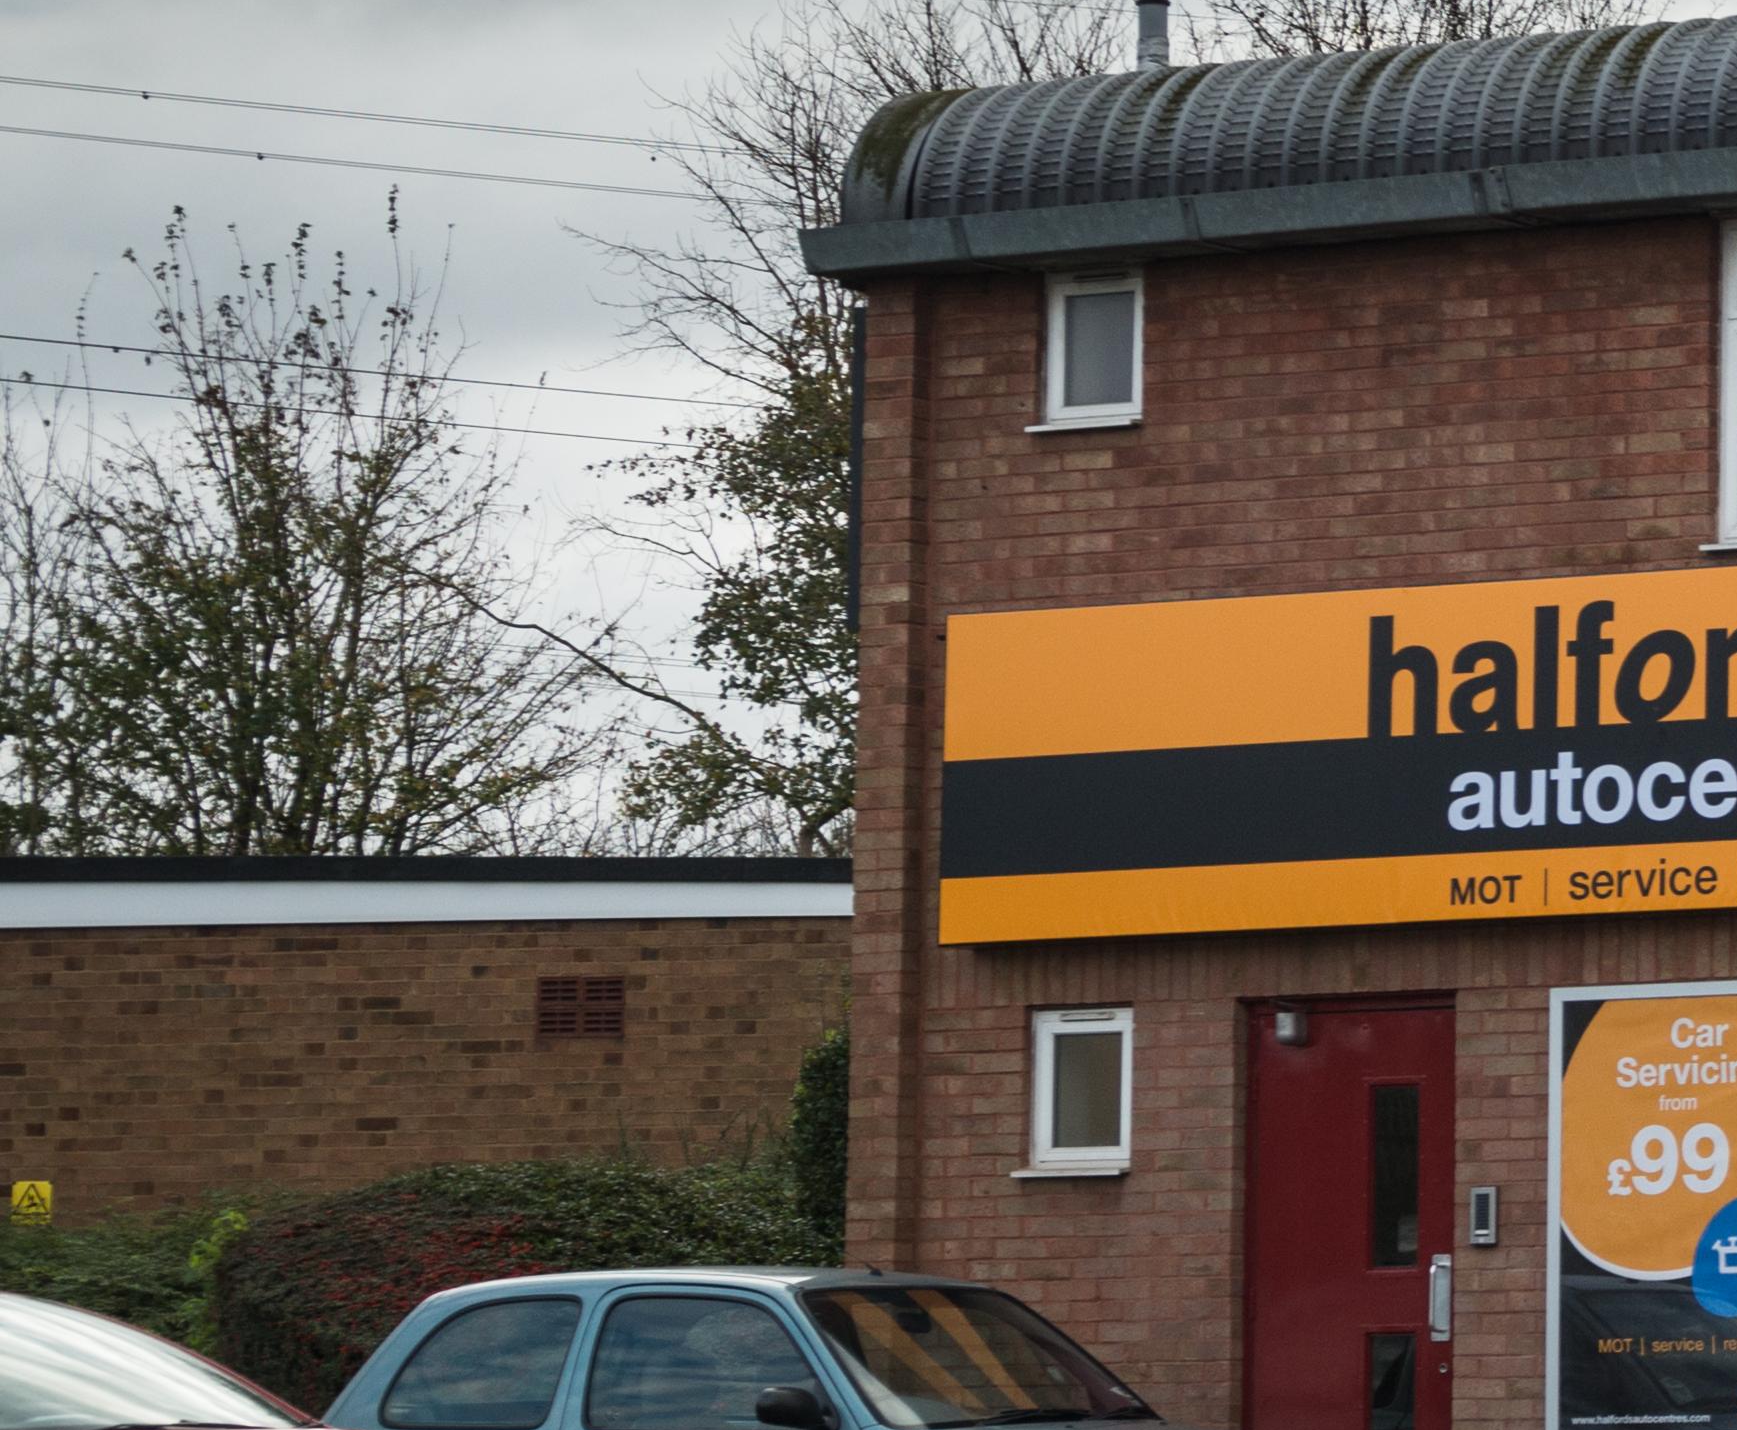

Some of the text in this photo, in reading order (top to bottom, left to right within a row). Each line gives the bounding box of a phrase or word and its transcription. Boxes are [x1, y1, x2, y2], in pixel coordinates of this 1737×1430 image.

[1450, 874, 1523, 905] MOT
[1568, 859, 1718, 901] service
[1670, 1017, 1729, 1049] Car
[1659, 1095, 1697, 1111] from
[1607, 1123, 1730, 1196] £99
[1598, 1337, 1634, 1353] MOT
[1651, 1337, 1704, 1353] service
[1571, 1414, 1711, 1425] www.halfordsautocentres.com
